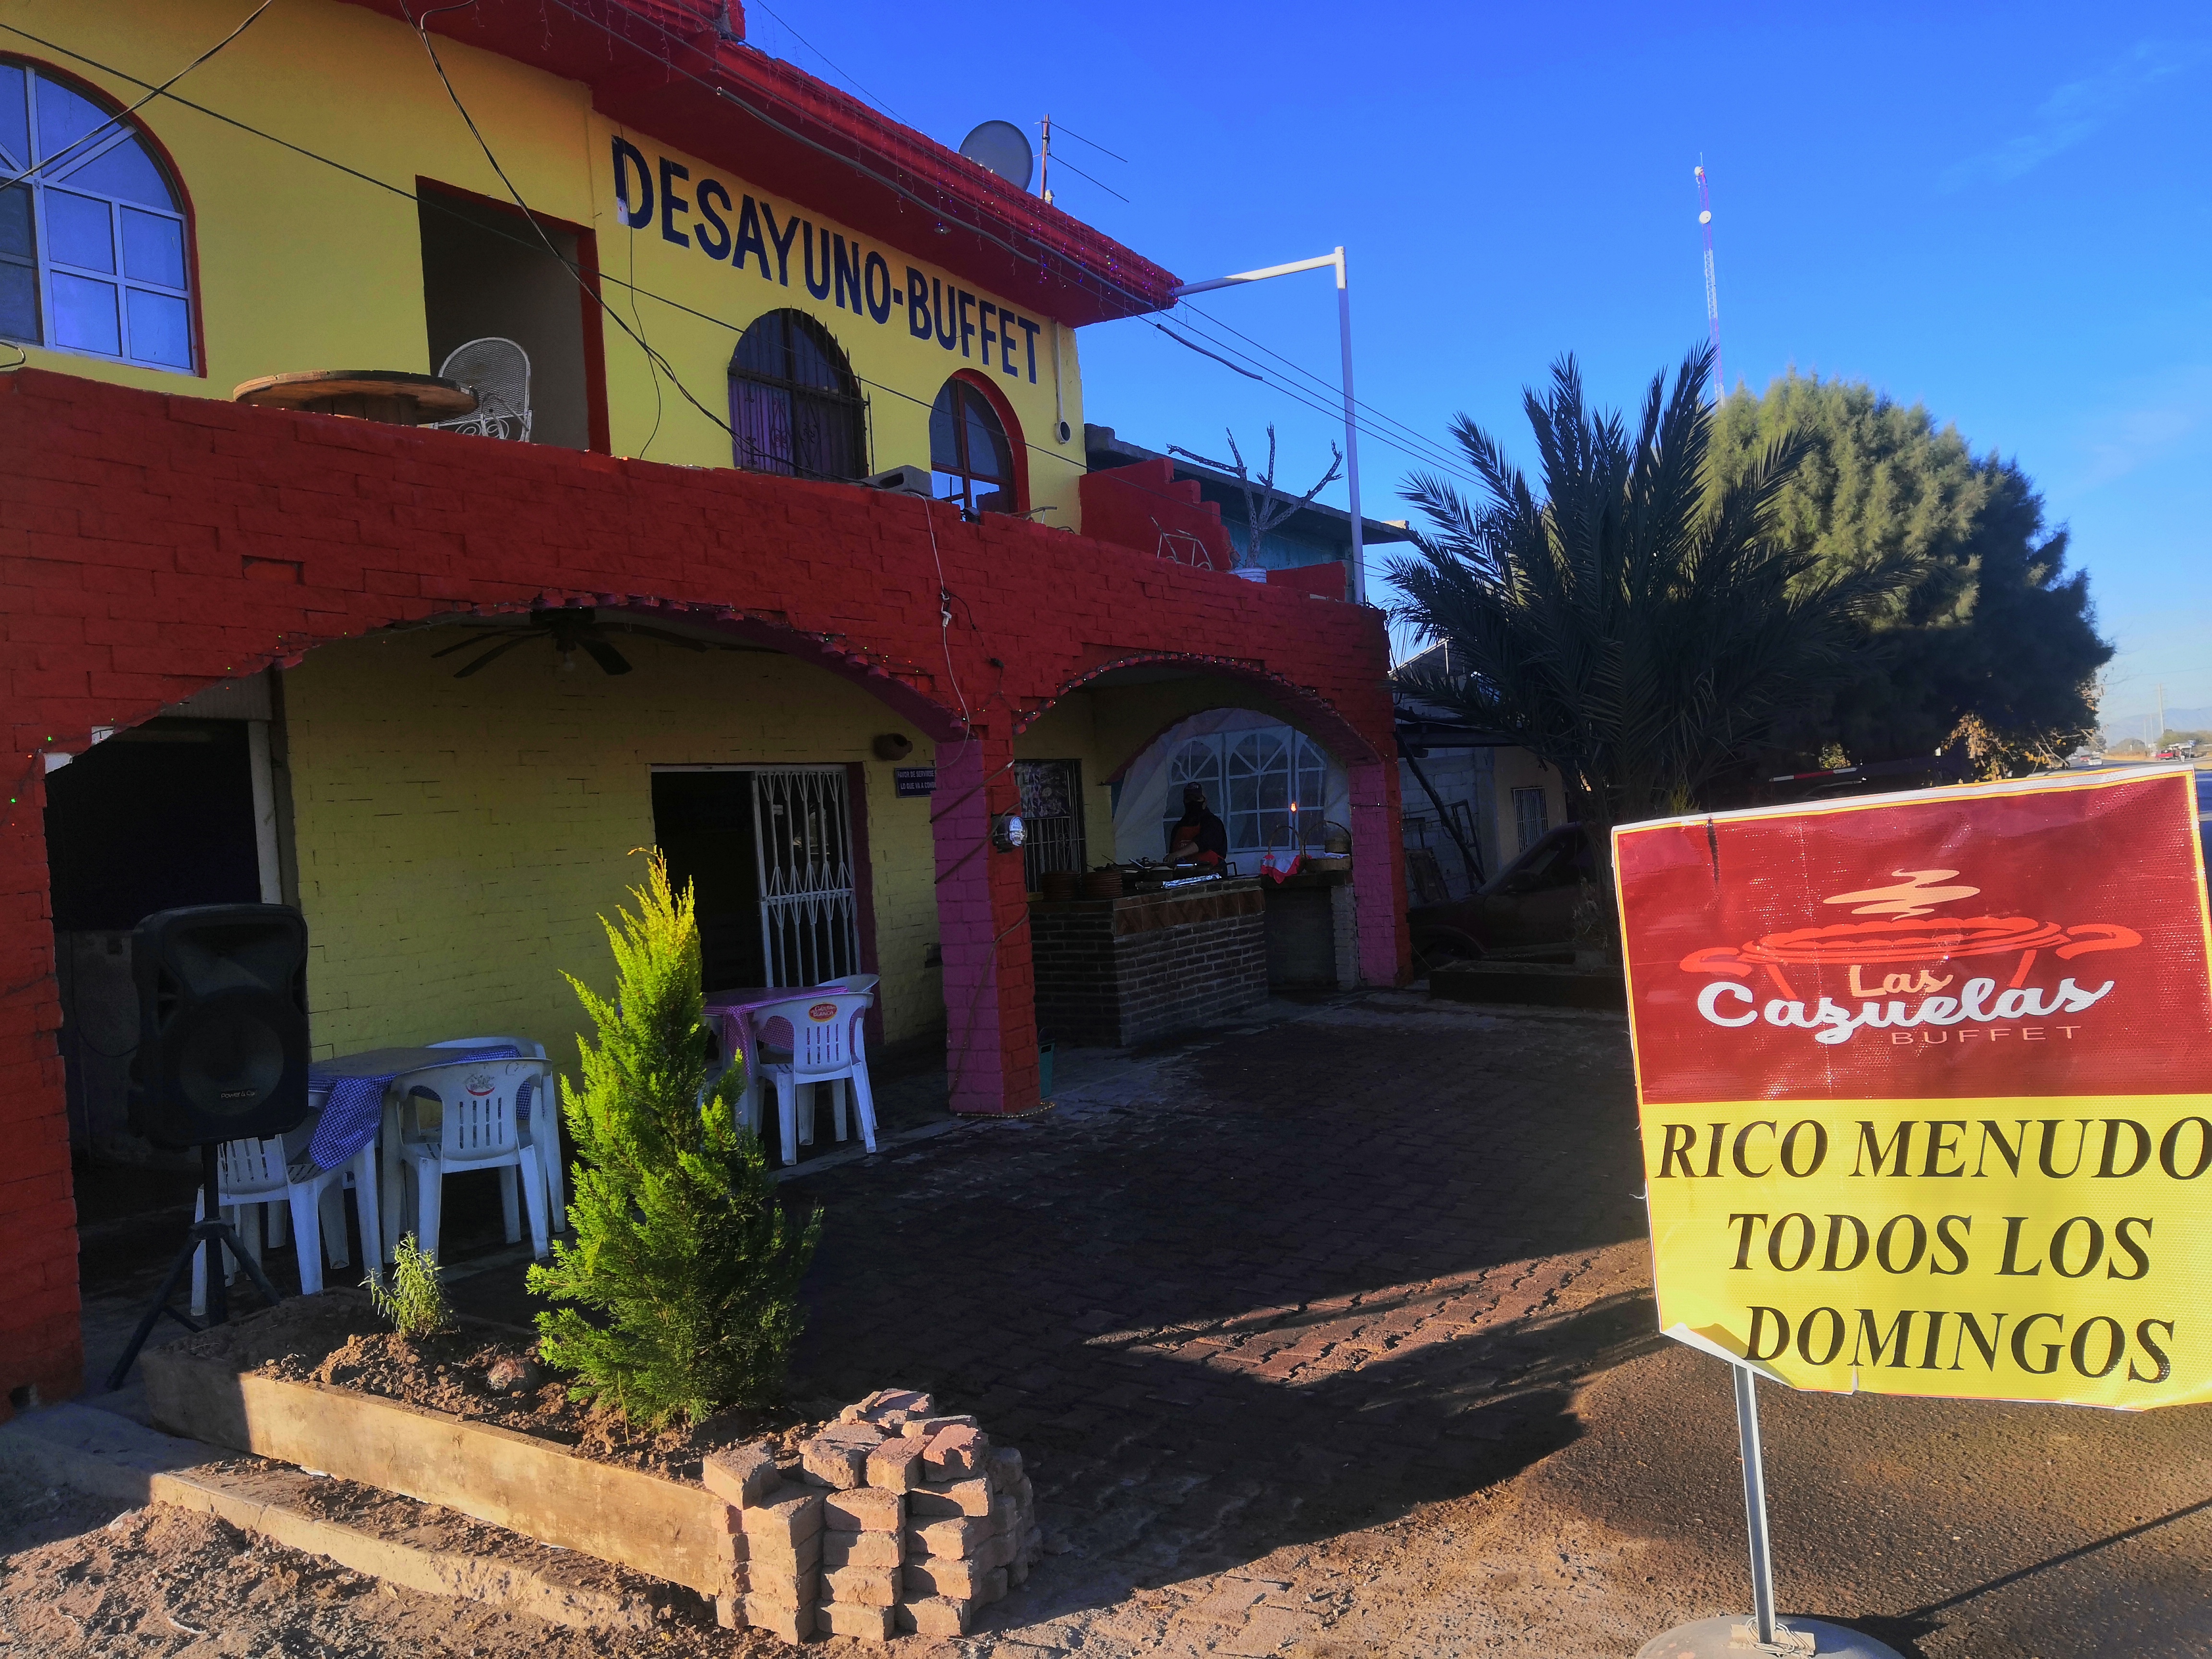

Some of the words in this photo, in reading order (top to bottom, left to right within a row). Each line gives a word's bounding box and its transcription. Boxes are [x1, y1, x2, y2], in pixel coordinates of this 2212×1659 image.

[611, 135, 1040, 384] DESAYUNO-BUFFET
[1697, 977, 2115, 1045] Cazuelas
[1848, 963, 1954, 998] Las
[1891, 1025, 2081, 1045] BUFFET
[1654, 1119, 1828, 1179] RICO
[1848, 1117, 2212, 1180] MENUDO
[1728, 1213, 1973, 1275] TODOS
[1994, 1215, 2154, 1281] LOS
[1743, 1305, 2176, 1384] DOMINGOS
